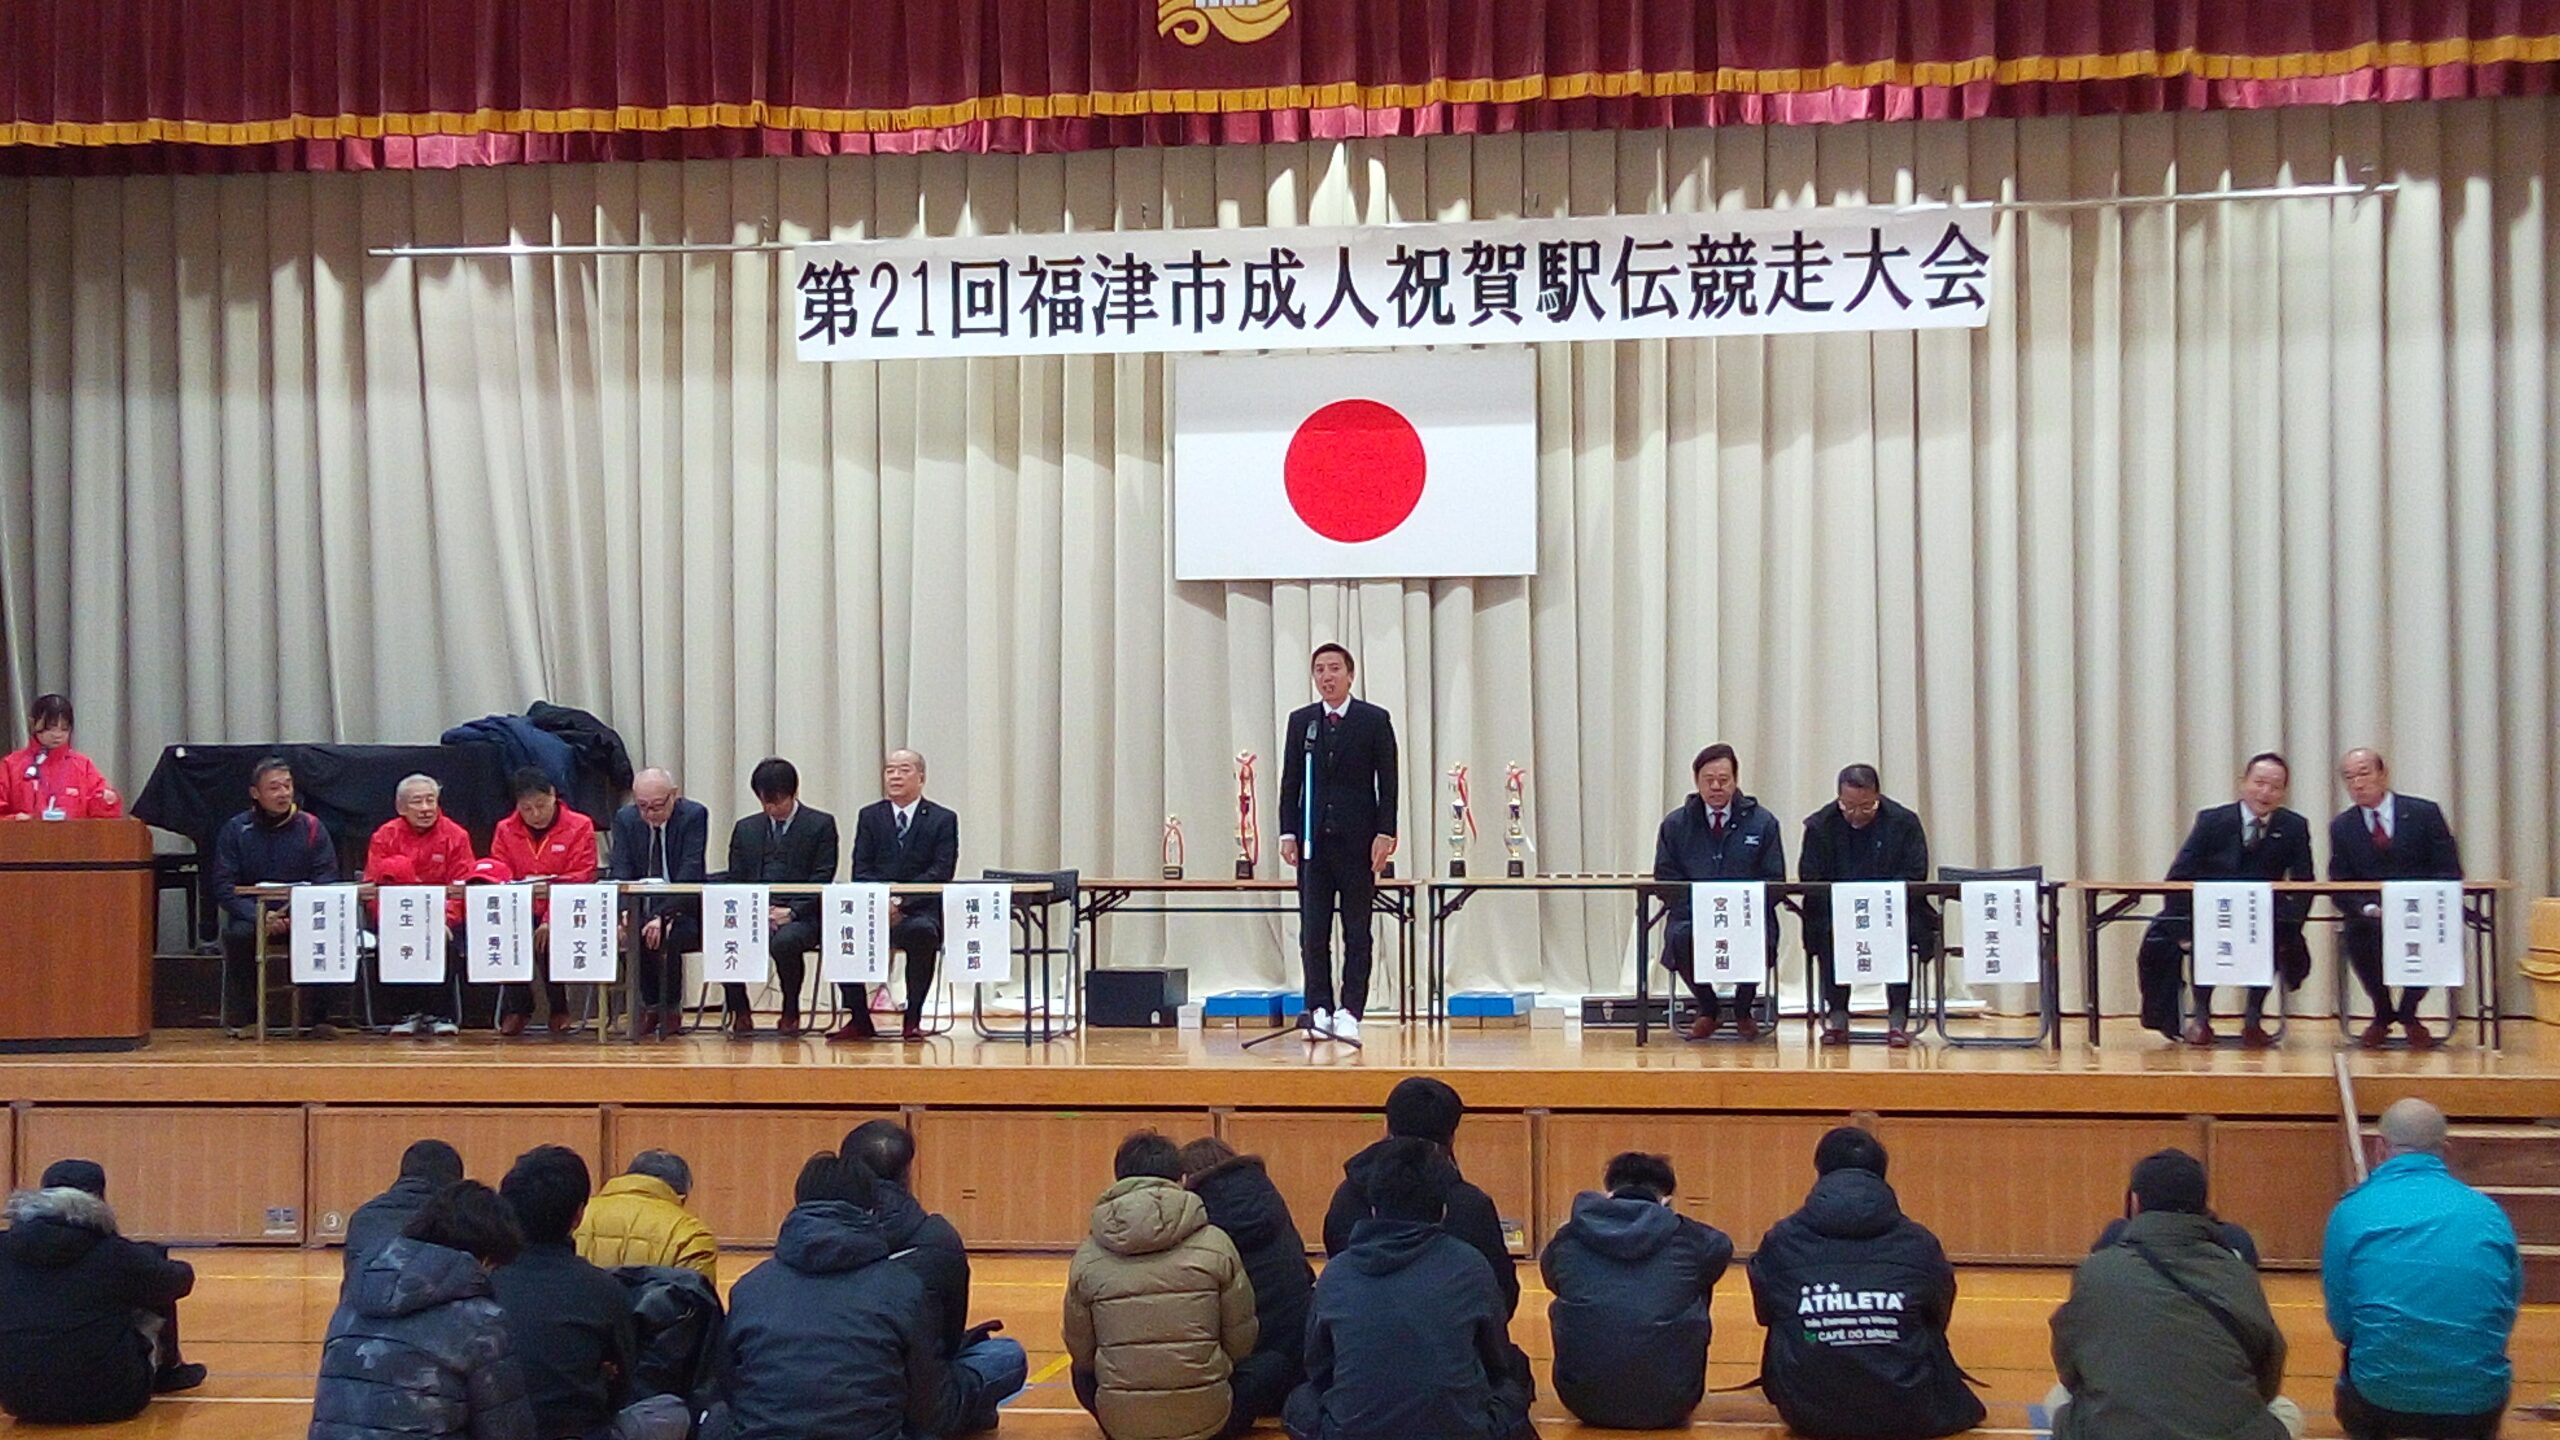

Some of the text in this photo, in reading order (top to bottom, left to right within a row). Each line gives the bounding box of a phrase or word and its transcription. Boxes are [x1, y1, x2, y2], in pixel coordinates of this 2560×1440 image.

[795, 222, 1990, 345] 第21回福津市成人祝賀駅伝競走大会
[966, 899, 980, 929] 福井
[1713, 897, 1728, 928] 宮内
[1798, 1292, 1904, 1315] ATHLETA
